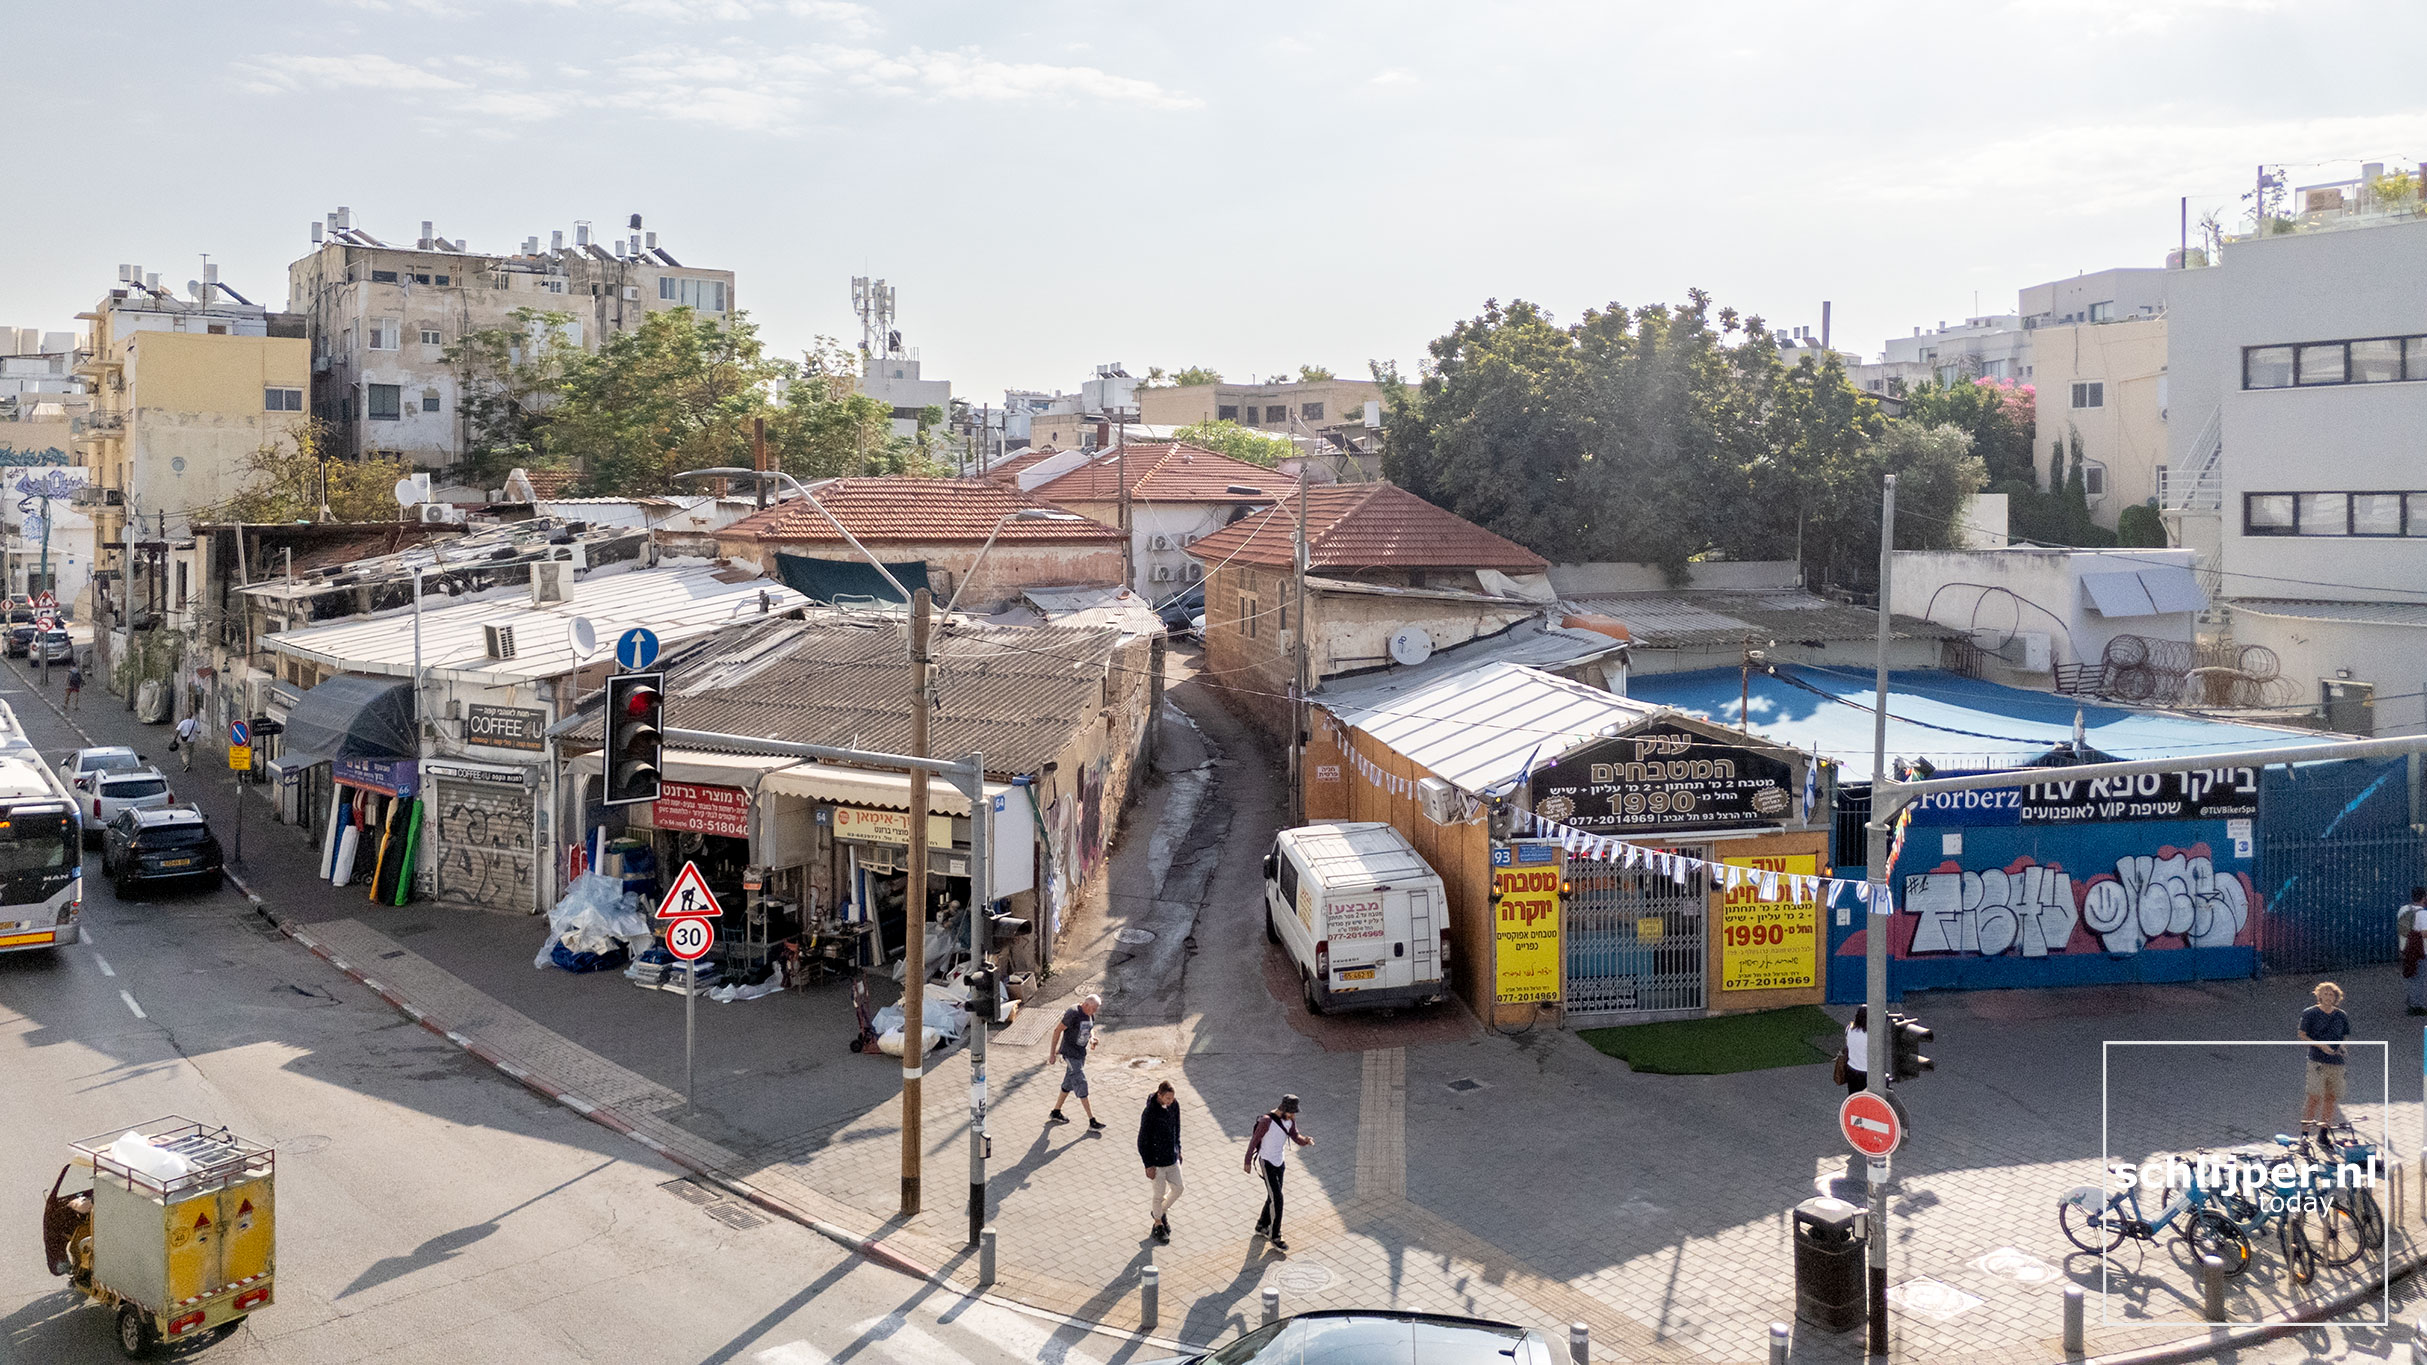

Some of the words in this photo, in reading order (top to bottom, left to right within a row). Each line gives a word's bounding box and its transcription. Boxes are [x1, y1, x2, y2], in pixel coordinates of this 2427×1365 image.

[484, 707, 496, 716] קפה
[471, 715, 543, 739] COFFEE4U
[1635, 734, 1692, 761] ענק
[1591, 759, 1735, 782] המטבחים
[285, 774, 299, 784] 66
[1737, 779, 1776, 788] מטבח
[2171, 767, 2256, 802] בייקר
[399, 785, 410, 795] 66
[1550, 786, 1577, 795] שיש
[1591, 784, 1621, 796] עליון
[1665, 782, 1706, 792] תחתון
[2089, 774, 2160, 798] ספא
[662, 785, 697, 799] ברזנט
[702, 789, 733, 803] מוצרי
[1714, 791, 1738, 800] החל
[995, 798, 1004, 809] 64
[1607, 791, 1696, 815] 1990
[2129, 801, 2182, 816] שטיפת
[1742, 811, 1758, 819] רח'
[2022, 803, 2094, 819] לאופנועים
[2099, 802, 2125, 817] VIP
[2200, 805, 2257, 816] @TLVBikerSpa
[816, 812, 826, 822] 64
[1569, 815, 1655, 826] 077-2014969
[1663, 814, 1684, 822] אביב
[1687, 812, 1700, 821] תל
[1717, 811, 1741, 820] הרצל
[874, 826, 891, 835] ברזנט
[1494, 851, 1510, 864] 93
[43, 874, 69, 882] MAN
[1328, 901, 1379, 915] מבצע!
[1725, 905, 1756, 915] תחתון
[1783, 903, 1812, 911] מטבח
[1501, 899, 1553, 927] יוקרה
[1757, 913, 1781, 923] עליון
[1531, 930, 1557, 939] מטבחים
[1797, 924, 1813, 934] החל
[676, 928, 701, 946] 30
[1328, 930, 1384, 941] 077-2014969
[1496, 931, 1529, 942] אפוקסיים
[1724, 924, 1784, 947] 1990
[1515, 943, 1539, 951] כפריים
[1726, 976, 1810, 988] 077-2014969
[1497, 991, 1558, 1002] 077-2014969
